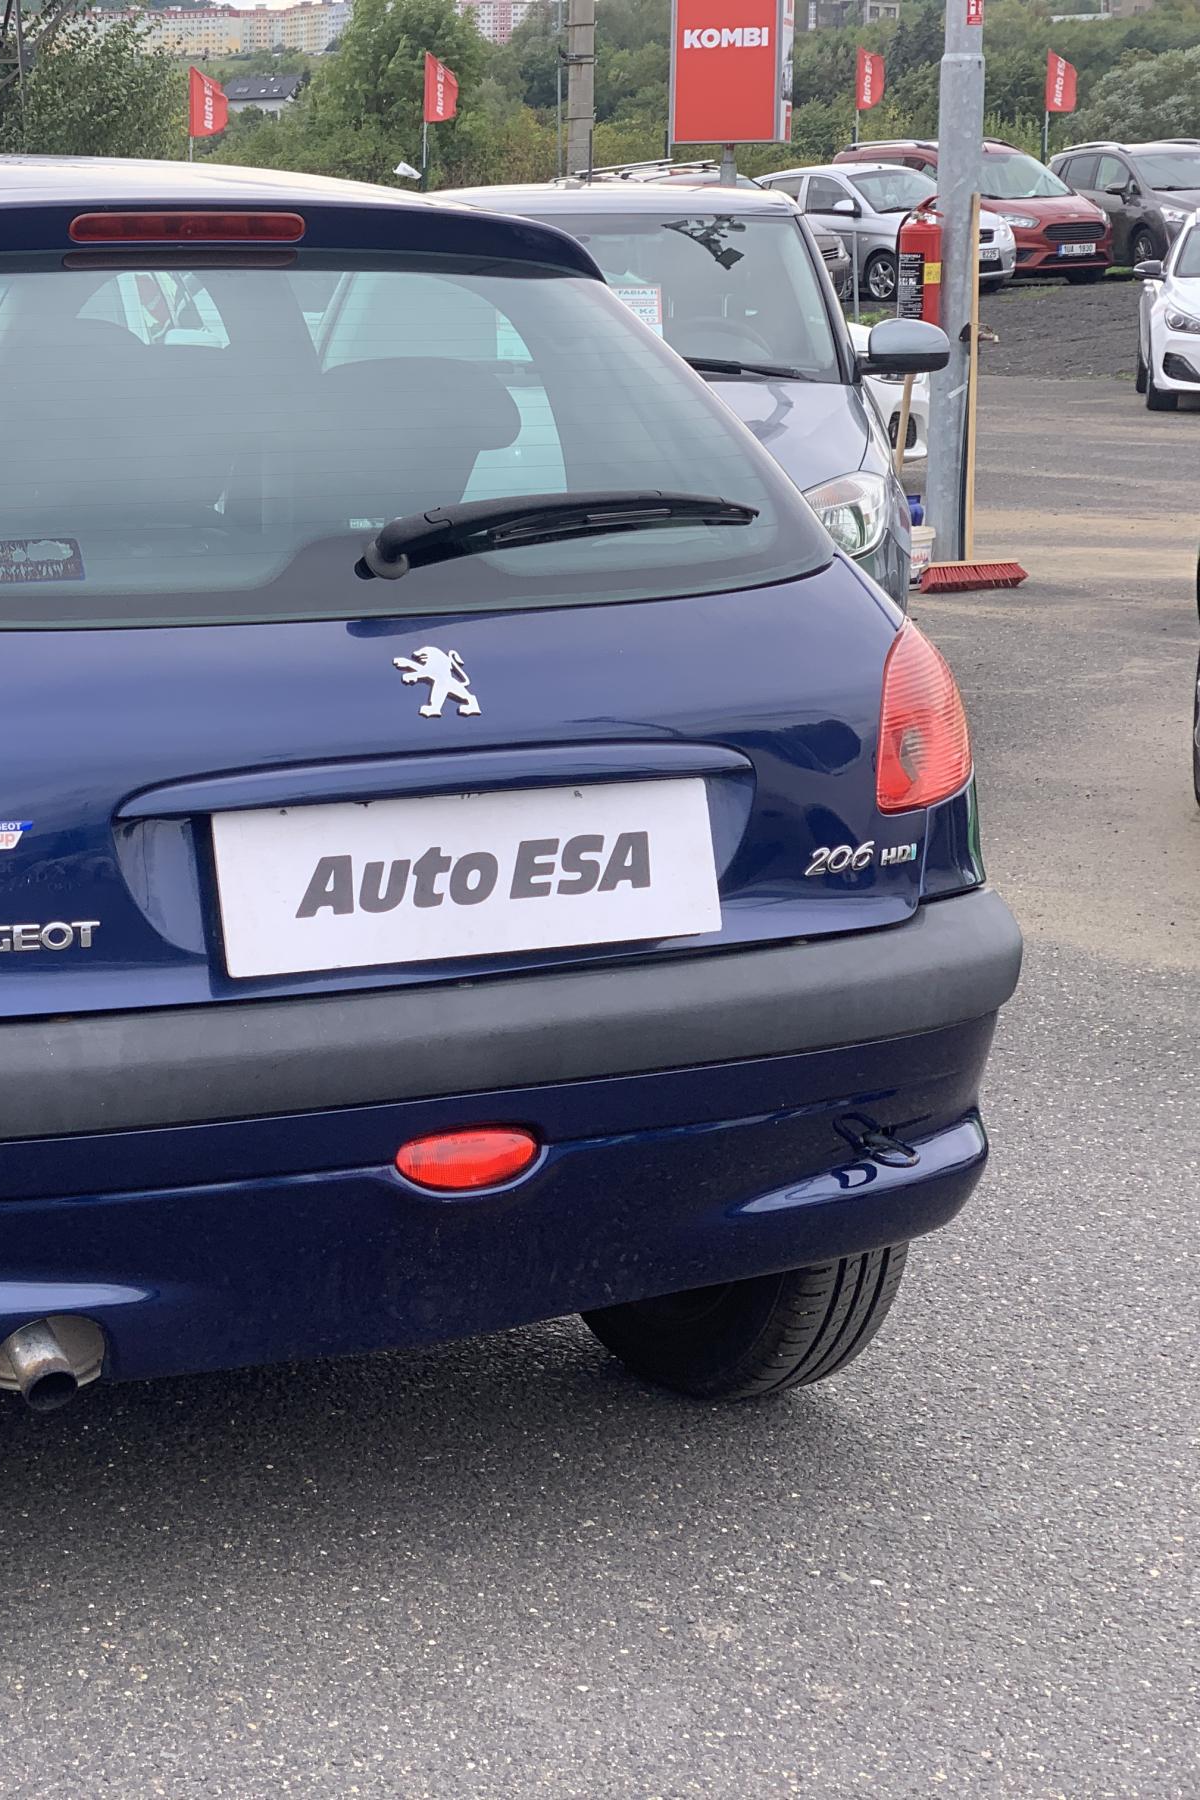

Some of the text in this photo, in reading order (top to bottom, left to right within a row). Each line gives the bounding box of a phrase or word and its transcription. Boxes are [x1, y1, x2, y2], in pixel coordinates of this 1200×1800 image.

[683, 26, 769, 49] KOMBI
[436, 83, 444, 116] Auto
[863, 74, 872, 104] Auto
[1053, 77, 1065, 106] Auto
[203, 96, 213, 130] Auto
[295, 830, 652, 919] Auto ESA
[804, 840, 875, 877] 206
